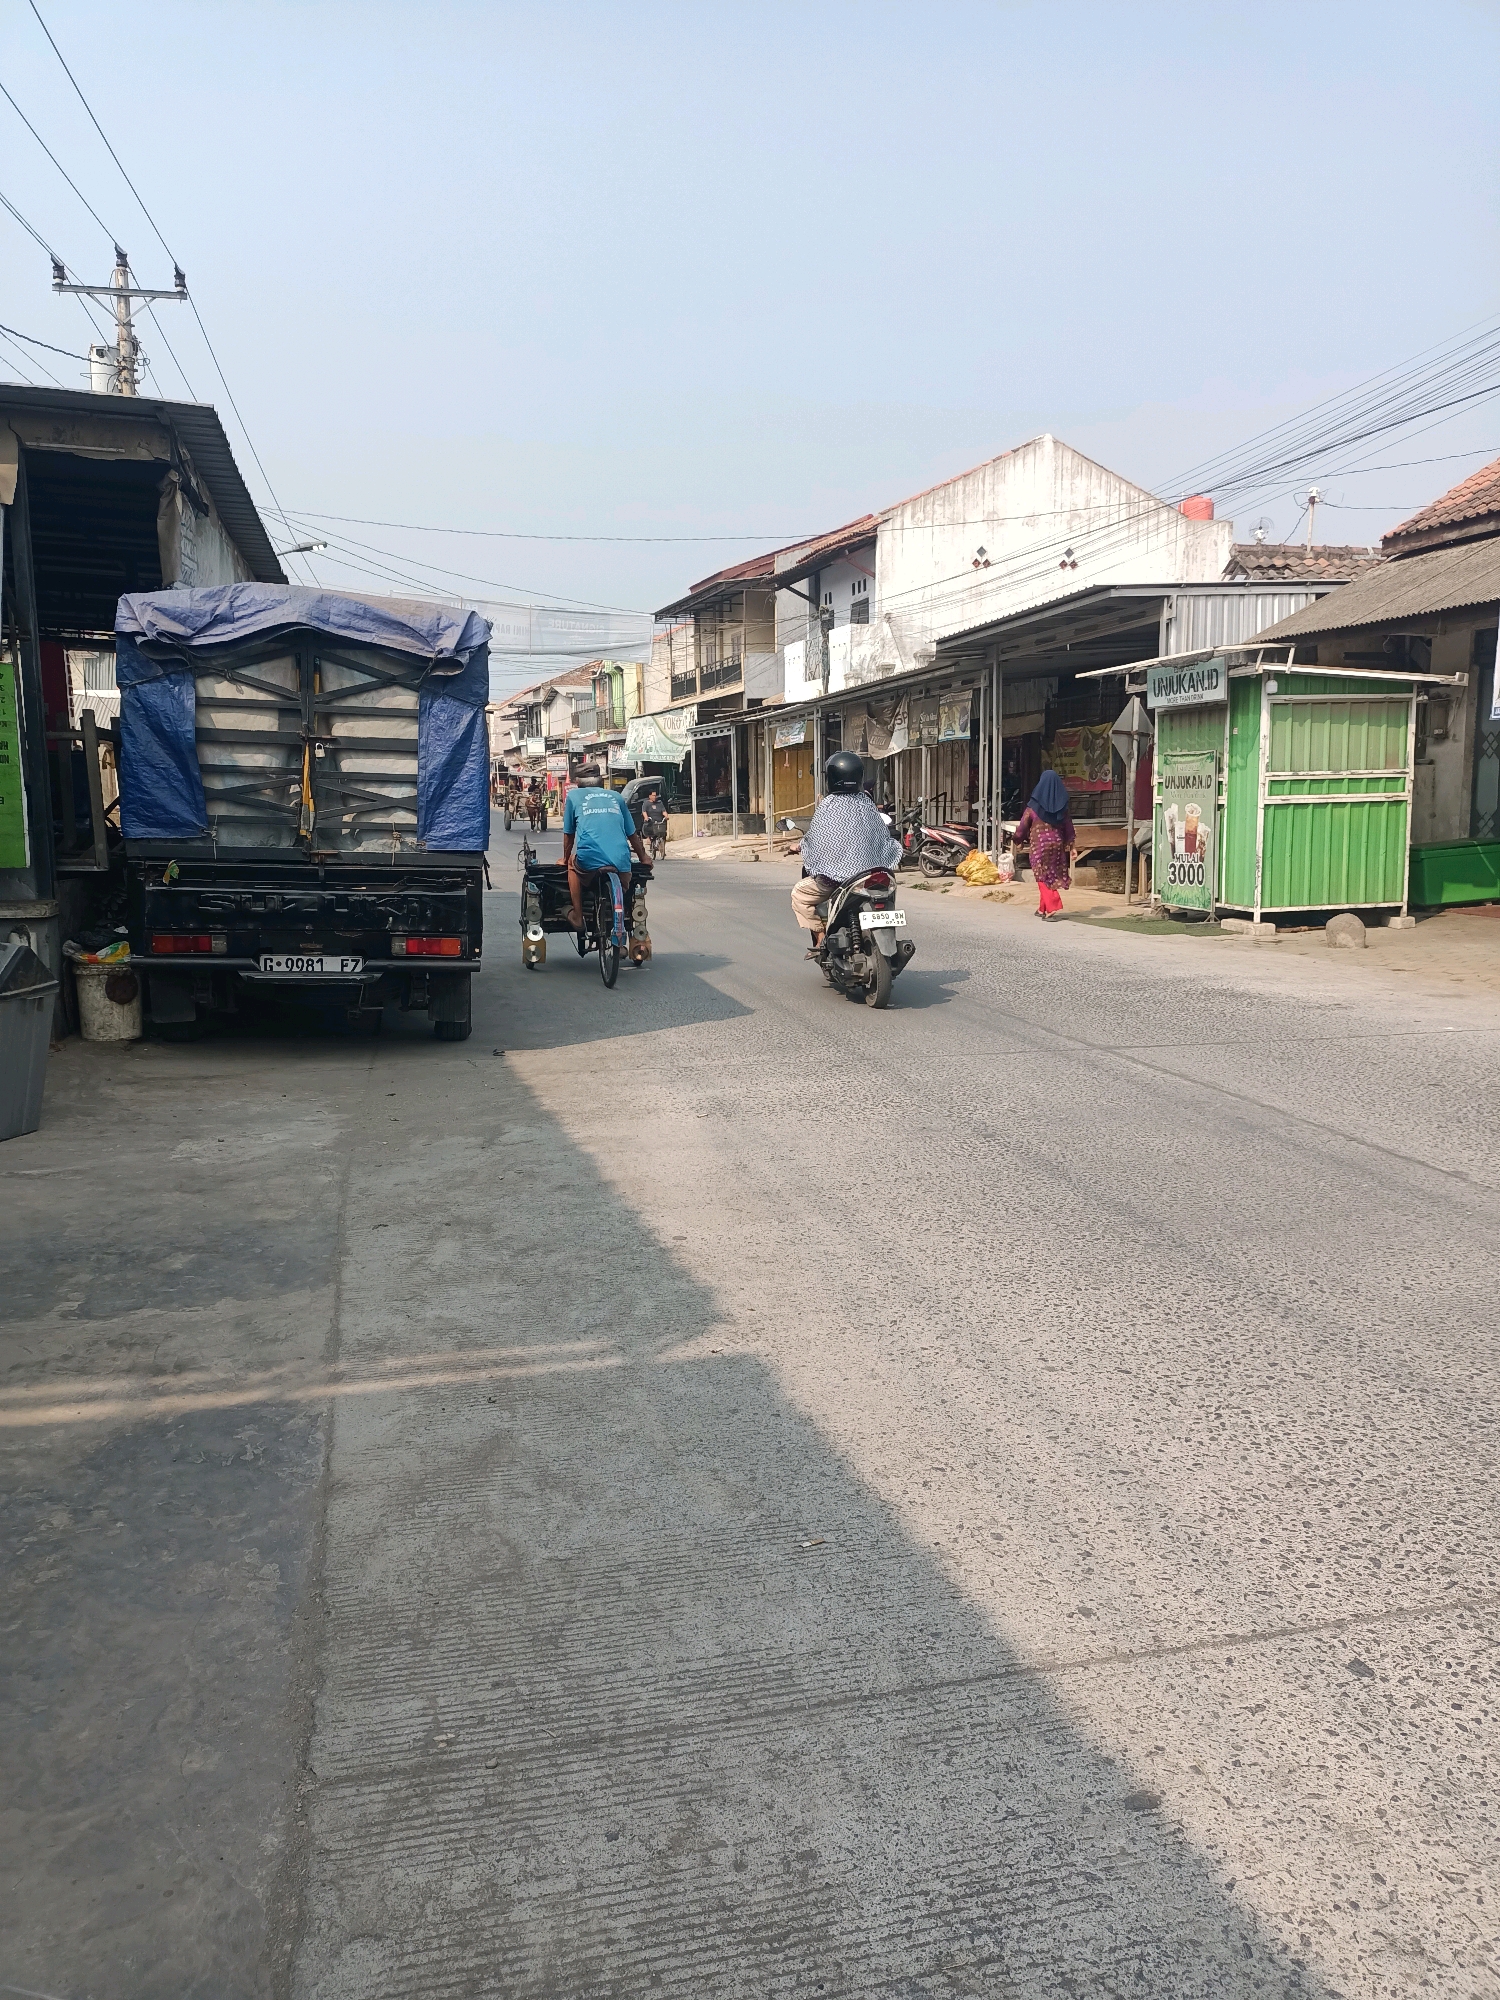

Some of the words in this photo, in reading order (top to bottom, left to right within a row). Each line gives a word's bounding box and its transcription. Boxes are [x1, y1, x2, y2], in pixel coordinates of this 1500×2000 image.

[1153, 668, 1219, 698] UNJUKAN.ID
[1164, 775, 1213, 790] UNJUKAN.ID
[1174, 853, 1199, 863] MULAI
[1168, 863, 1205, 886] 3000
[197, 893, 420, 916] SUZUKI
[285, 957, 324, 972] 9981
